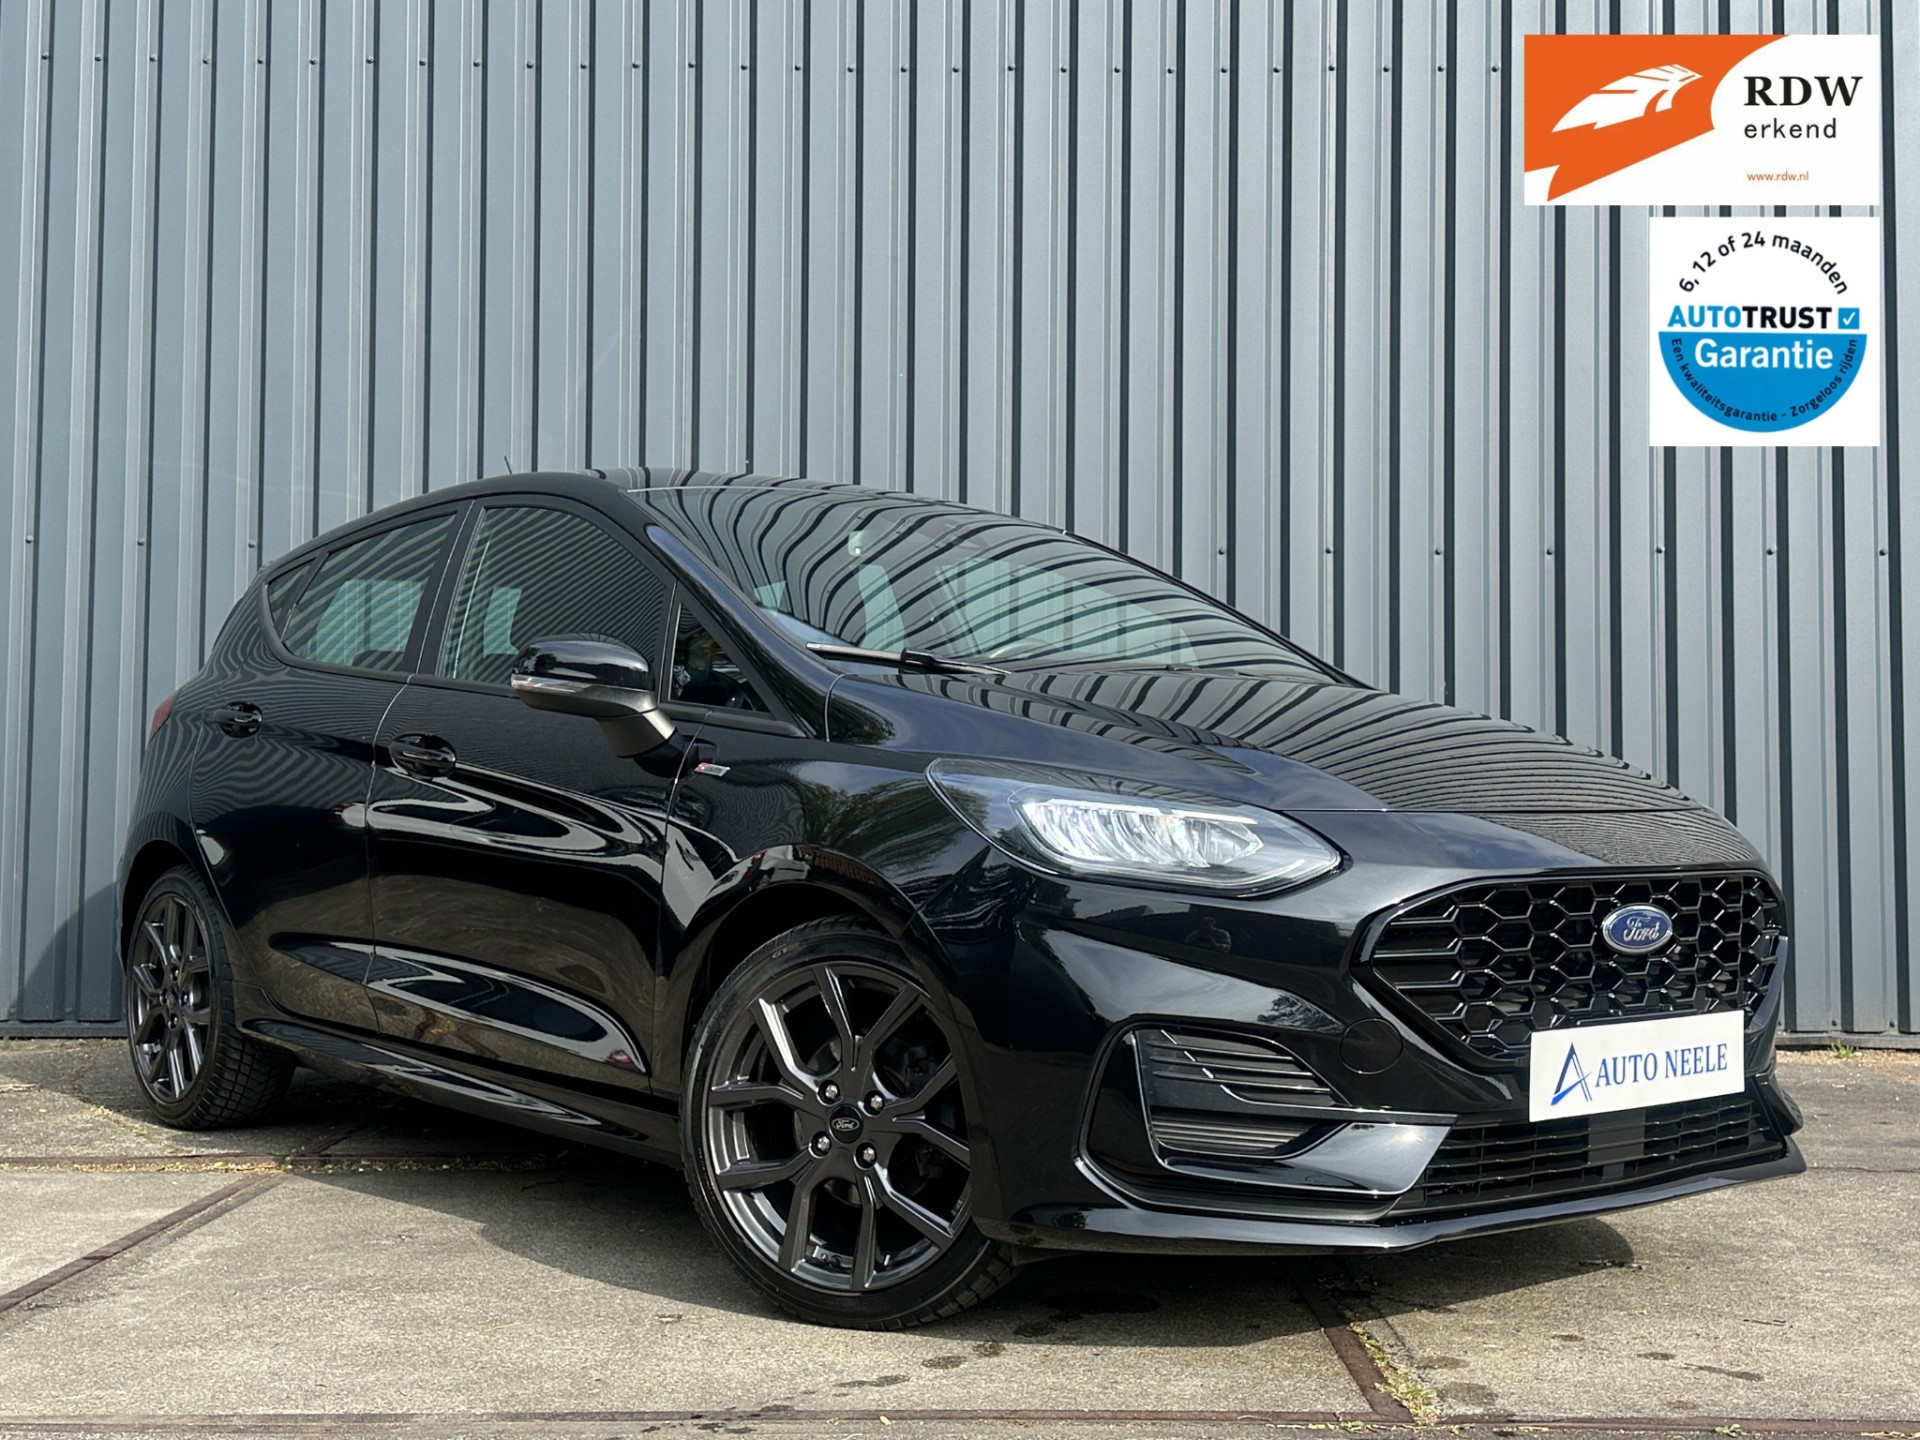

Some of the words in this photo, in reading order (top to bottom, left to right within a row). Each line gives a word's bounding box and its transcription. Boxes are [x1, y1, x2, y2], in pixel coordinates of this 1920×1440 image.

[1623, 916, 1661, 942] Ford
[1595, 1052, 1658, 1087] AUTO
[1664, 1043, 1728, 1079] NEELE
[836, 1120, 855, 1129] Ford
